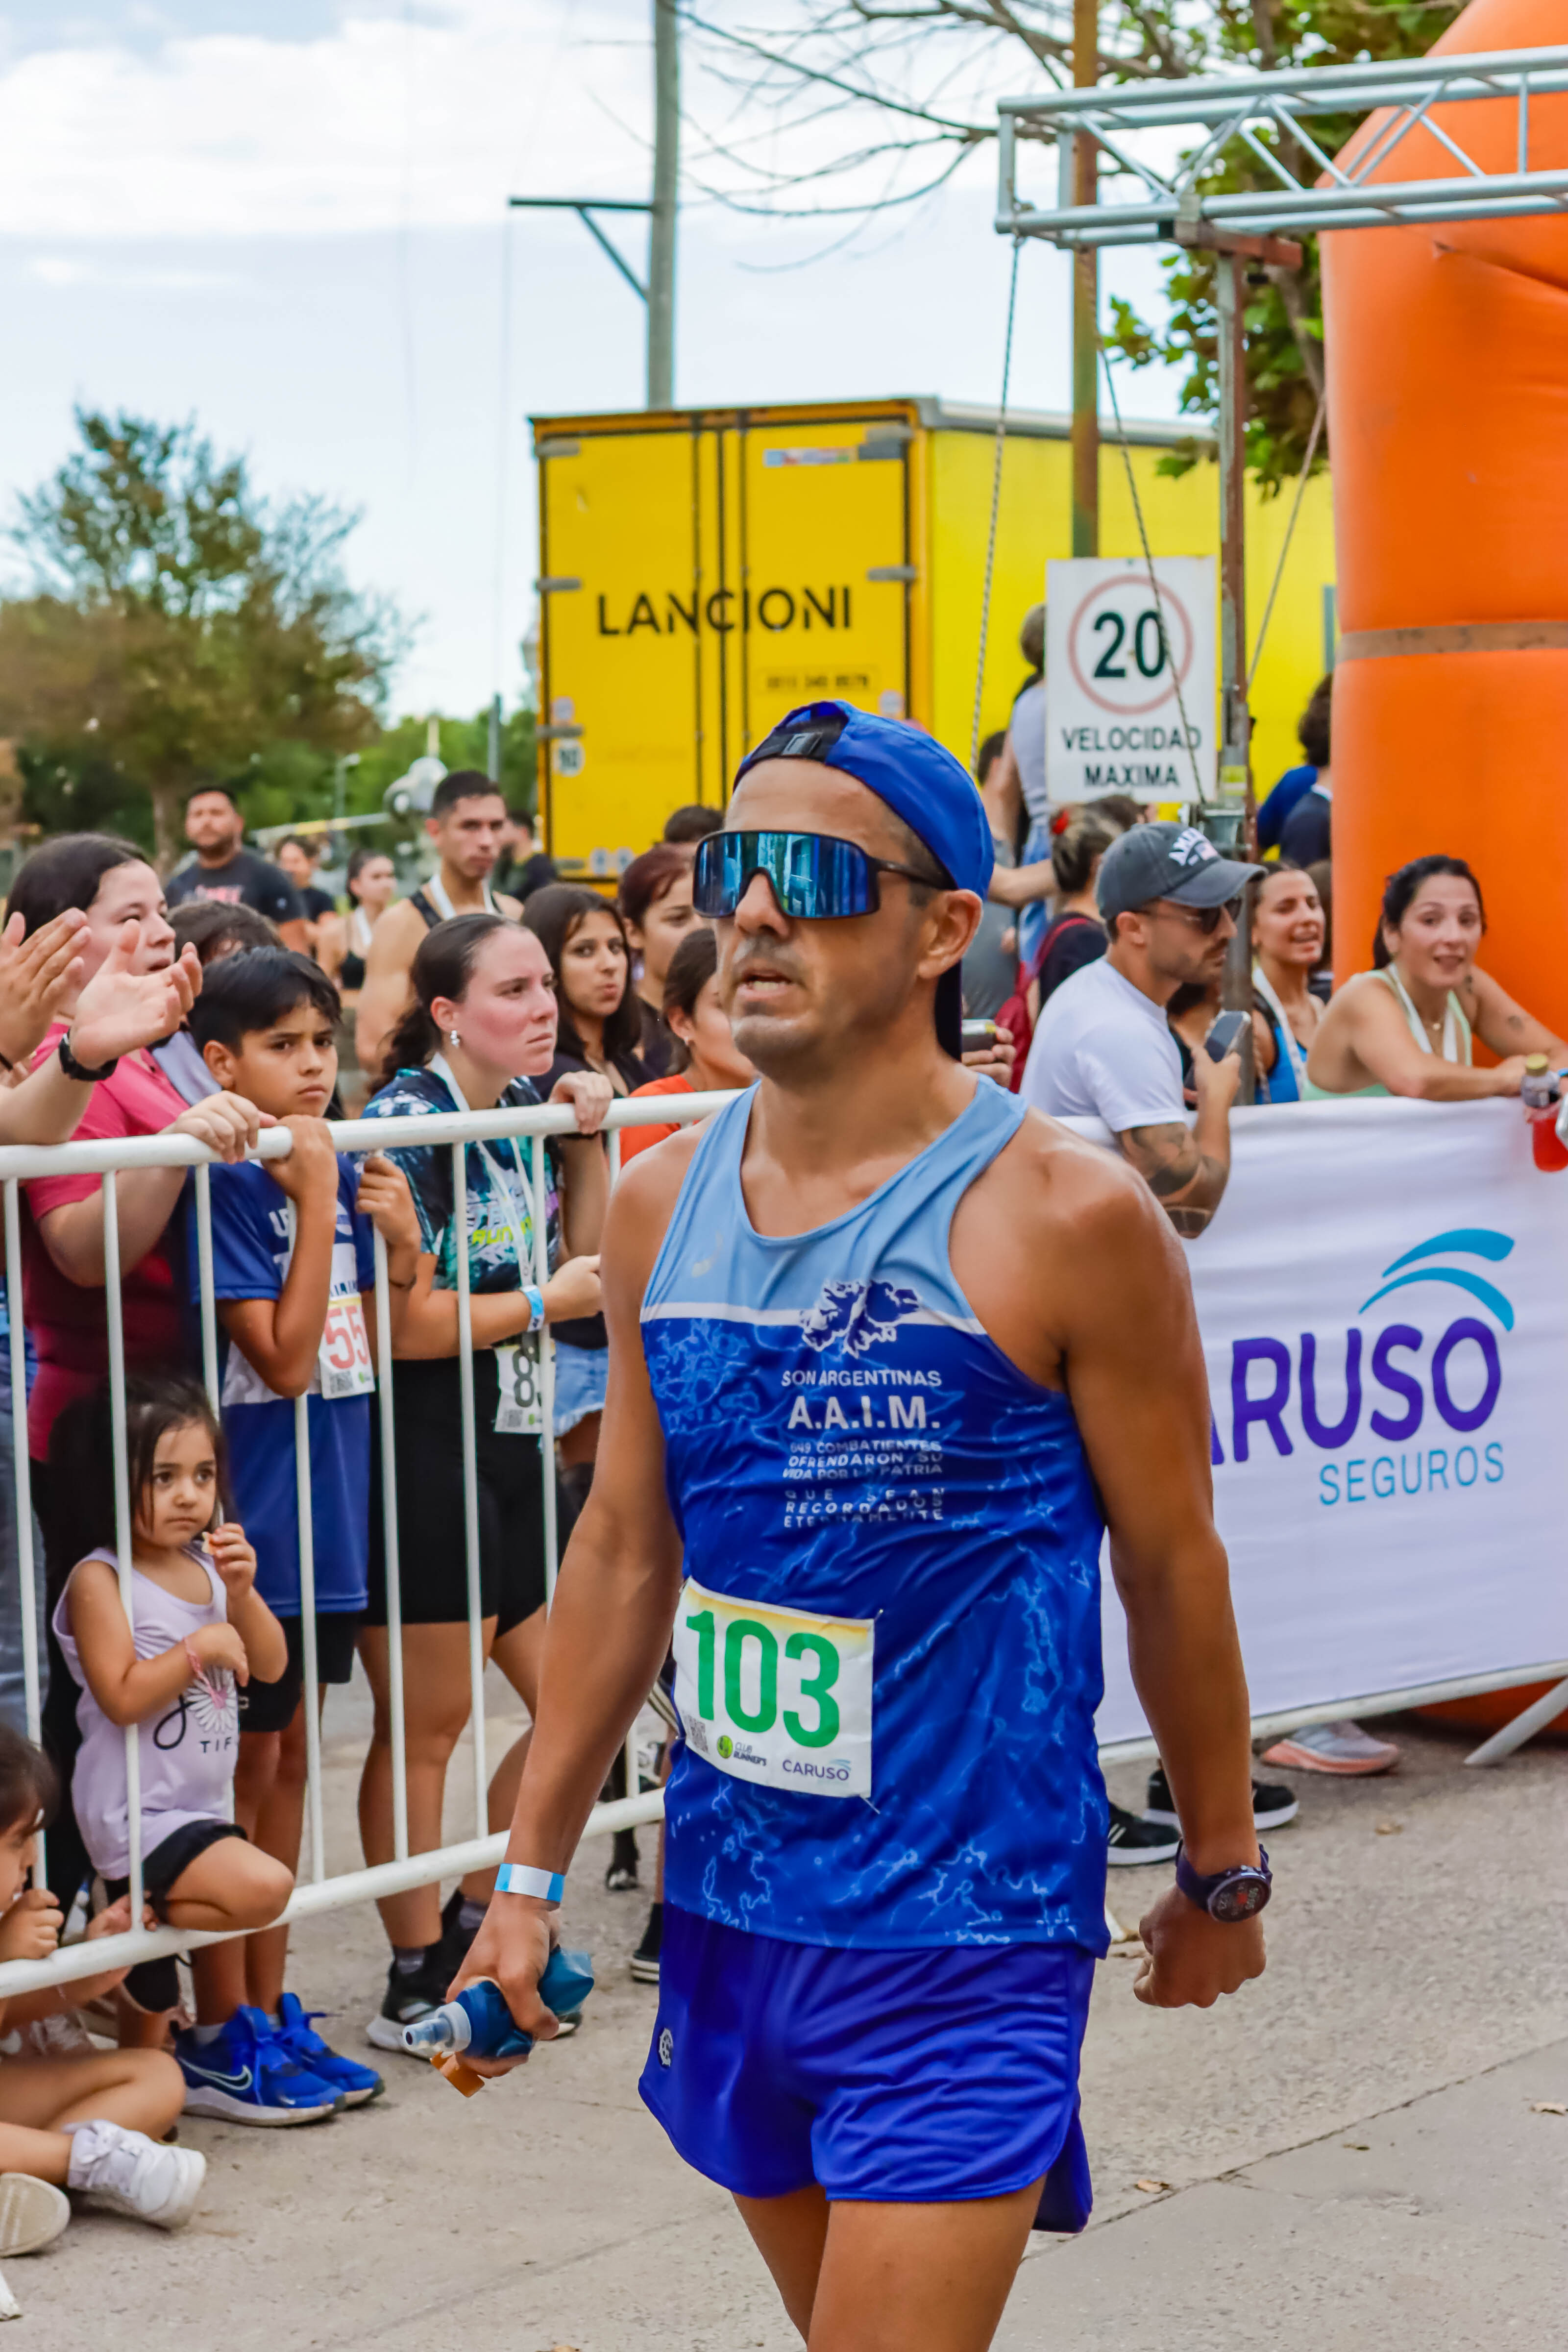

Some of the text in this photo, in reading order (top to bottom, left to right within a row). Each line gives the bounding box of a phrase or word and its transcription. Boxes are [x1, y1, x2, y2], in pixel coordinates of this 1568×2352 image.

[599, 587, 850, 635] LANCIONI
[1093, 610, 1166, 678] 20
[1061, 726, 1202, 752] VELOCIDAD
[1084, 762, 1179, 788] MAXIMA
[782, 1370, 942, 1386] SON ARGENTINAS
[1211, 1317, 1501, 1466] RUSO
[787, 1395, 940, 1429] A.A.I.M.
[789, 1452, 903, 1468] OFRENDARON
[1320, 1442, 1504, 1505] SEGUROS
[686, 1610, 839, 1748] 103
[783, 1759, 849, 1781] CARUSO
